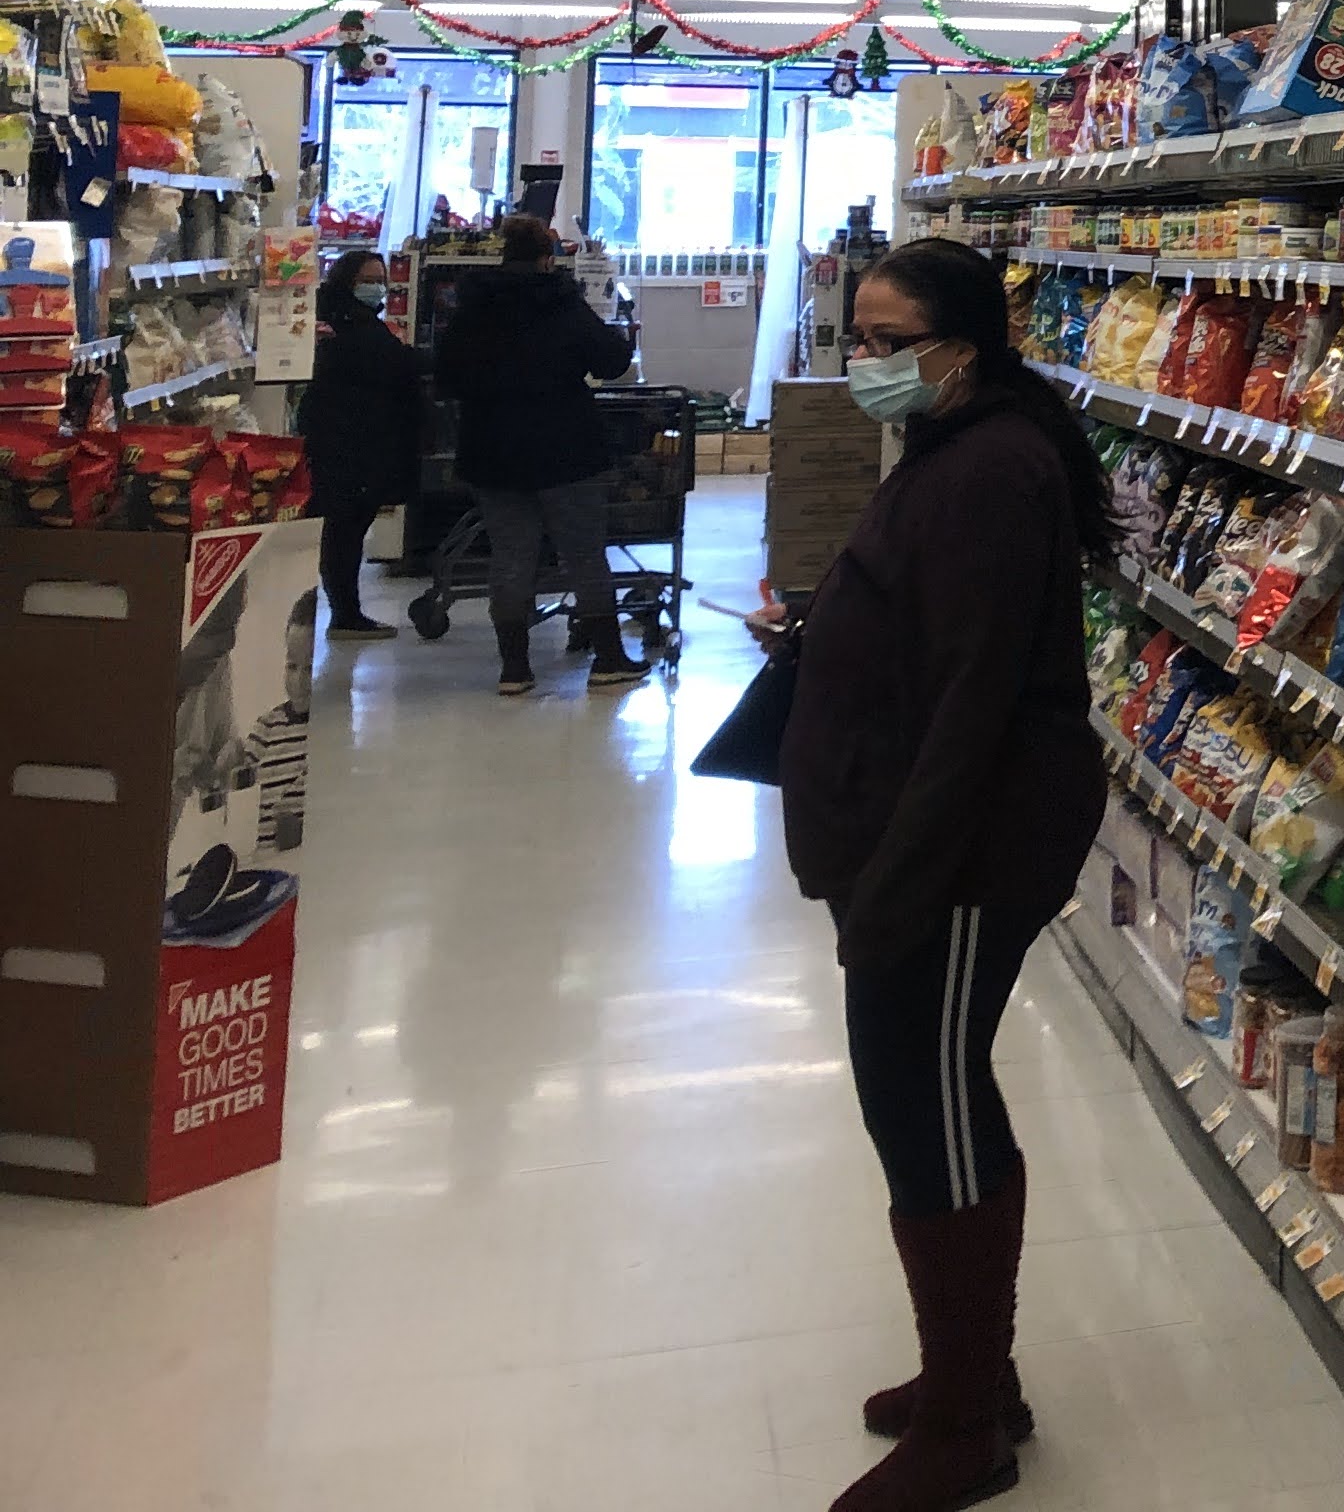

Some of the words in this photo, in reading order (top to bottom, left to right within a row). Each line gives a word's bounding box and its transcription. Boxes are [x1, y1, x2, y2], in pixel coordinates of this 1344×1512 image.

[179, 974, 272, 1031] MAKE
[177, 1010, 269, 1065] GOOD
[177, 1056, 264, 1102] TIMES
[173, 1082, 266, 1136] BETTER
